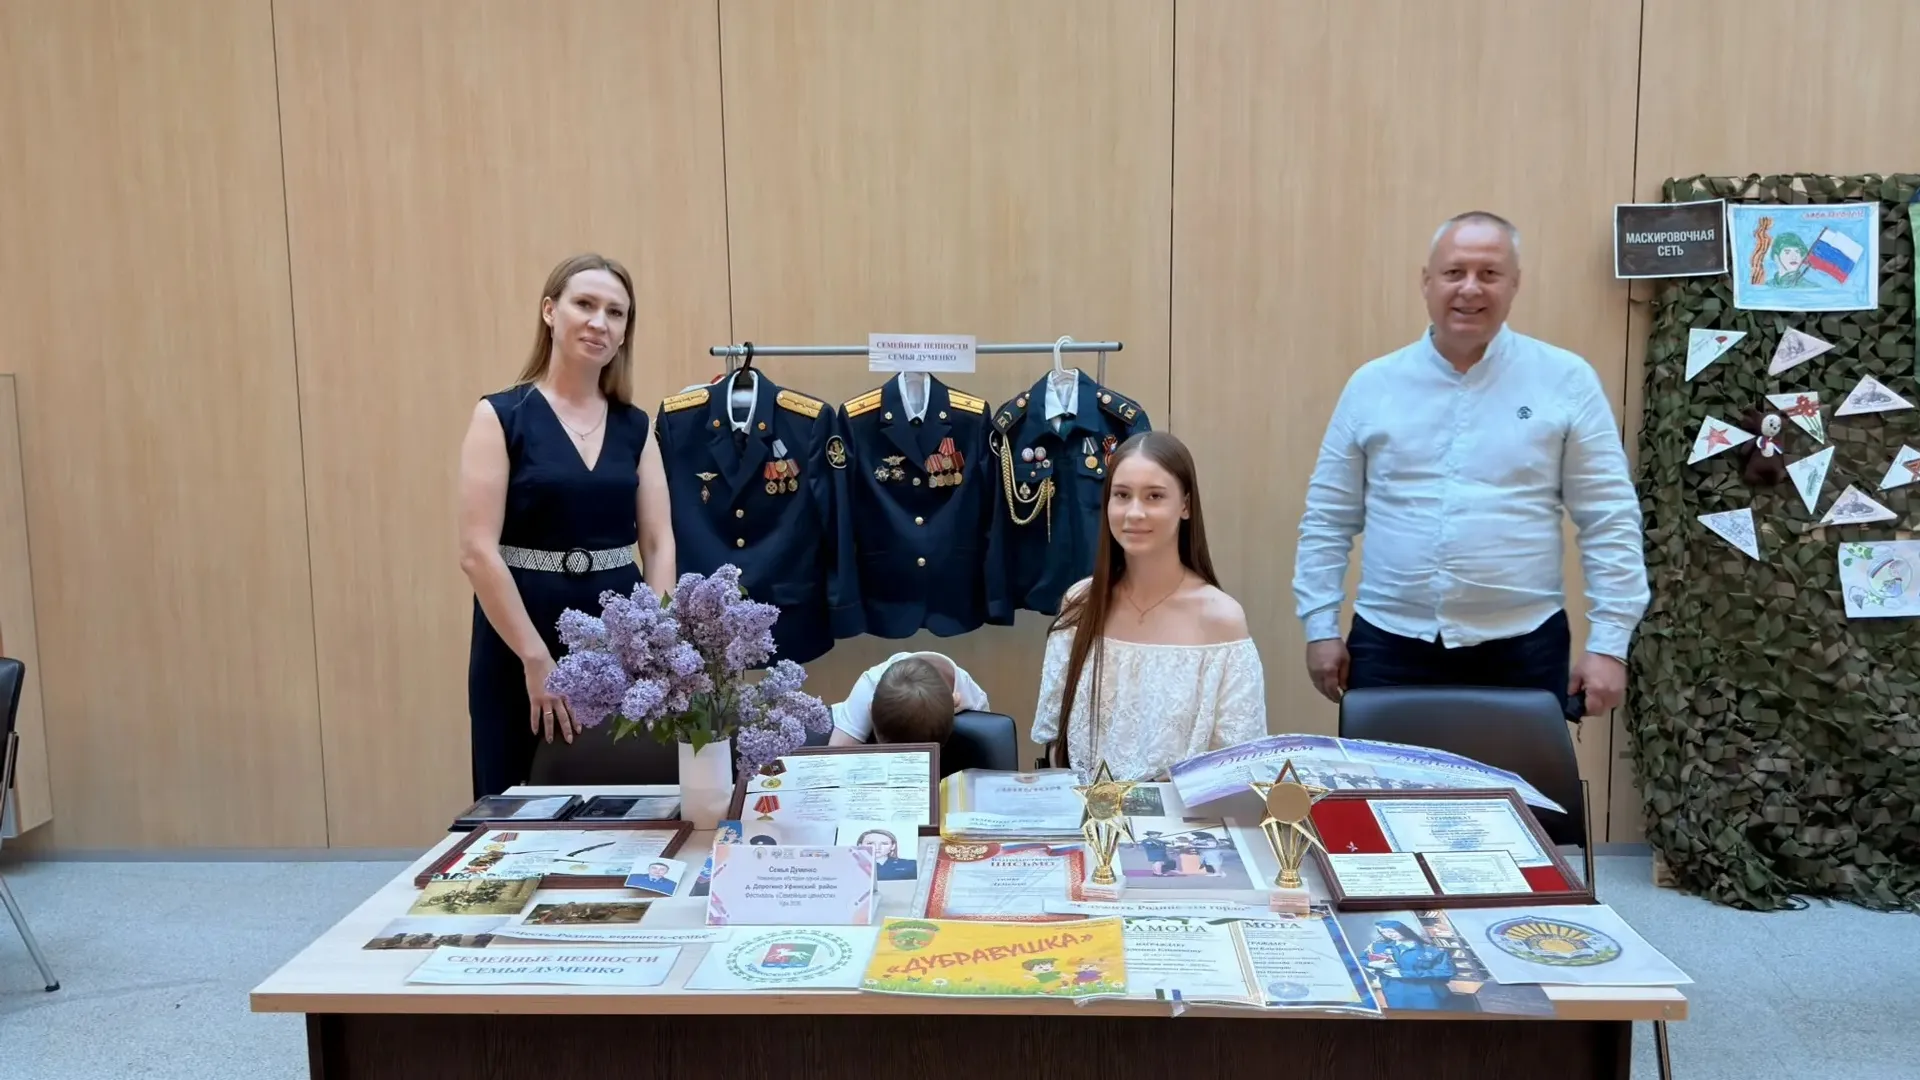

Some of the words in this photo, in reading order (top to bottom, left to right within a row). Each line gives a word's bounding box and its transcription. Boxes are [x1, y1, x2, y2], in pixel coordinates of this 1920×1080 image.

[1626, 229, 1715, 244] МАСКИРОВОЧНАЯ
[1657, 245, 1684, 257] СЕТЬ
[876, 341, 921, 350] СЕМЕЙНЫЕ
[923, 342, 969, 351] ЦЕННОСТИ
[888, 353, 915, 361] СЕМЬЯ
[916, 354, 957, 362] ДУМЕНКО
[768, 865, 789, 873] Семья
[790, 865, 817, 874] Думенко
[818, 883, 838, 891] район
[1123, 925, 1208, 933] РАМОТА
[1244, 921, 1303, 929] МОТА
[447, 953, 553, 965] СЕМЕЙНЫЕ
[556, 955, 659, 965] ЦЕННОСТИ
[886, 932, 1094, 977] «ДУБРАВУШКА»
[463, 965, 532, 975] СЕМЬЯ
[532, 966, 624, 975] ДУМЕНКО
